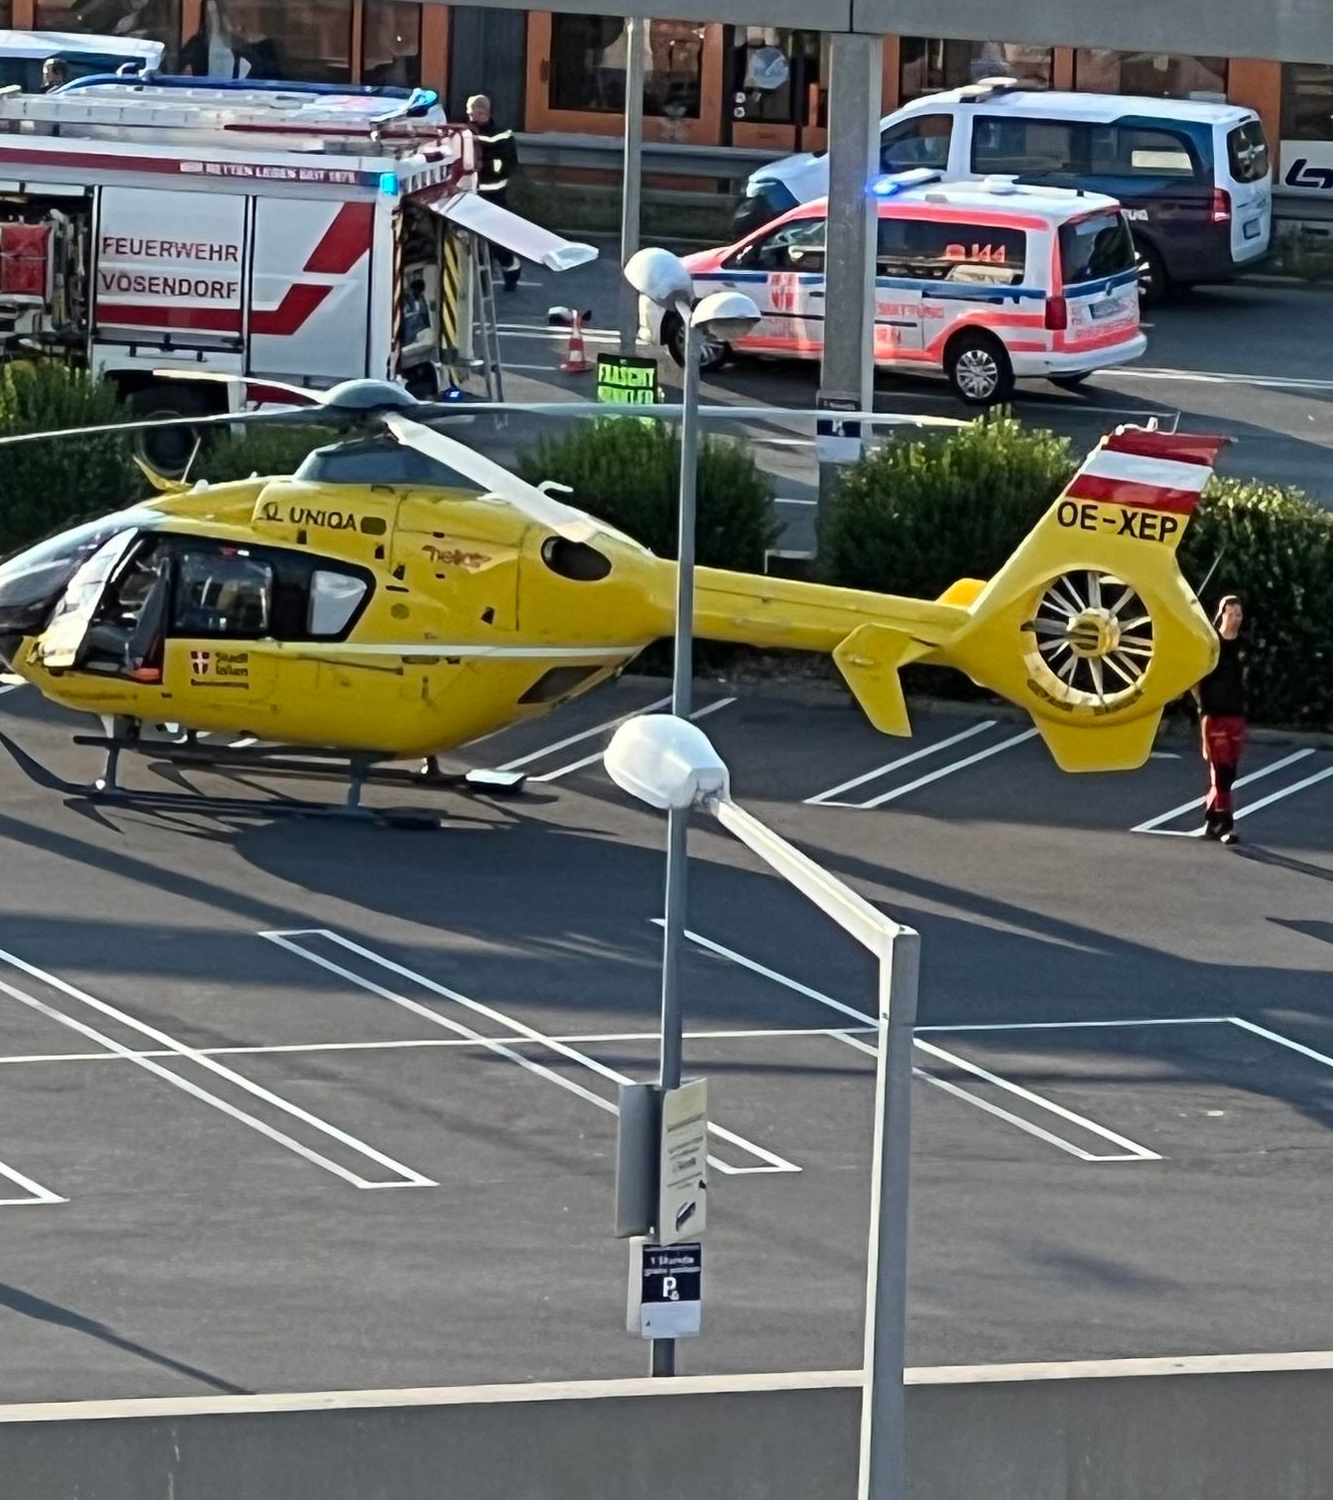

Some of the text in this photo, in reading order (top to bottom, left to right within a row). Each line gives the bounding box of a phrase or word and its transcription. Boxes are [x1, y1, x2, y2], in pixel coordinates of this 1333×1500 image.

[102, 236, 239, 263] FEUERWEHR
[289, 506, 358, 532] UNIQA
[1057, 501, 1178, 542] OE-XEP
[663, 1276, 677, 1297] P
